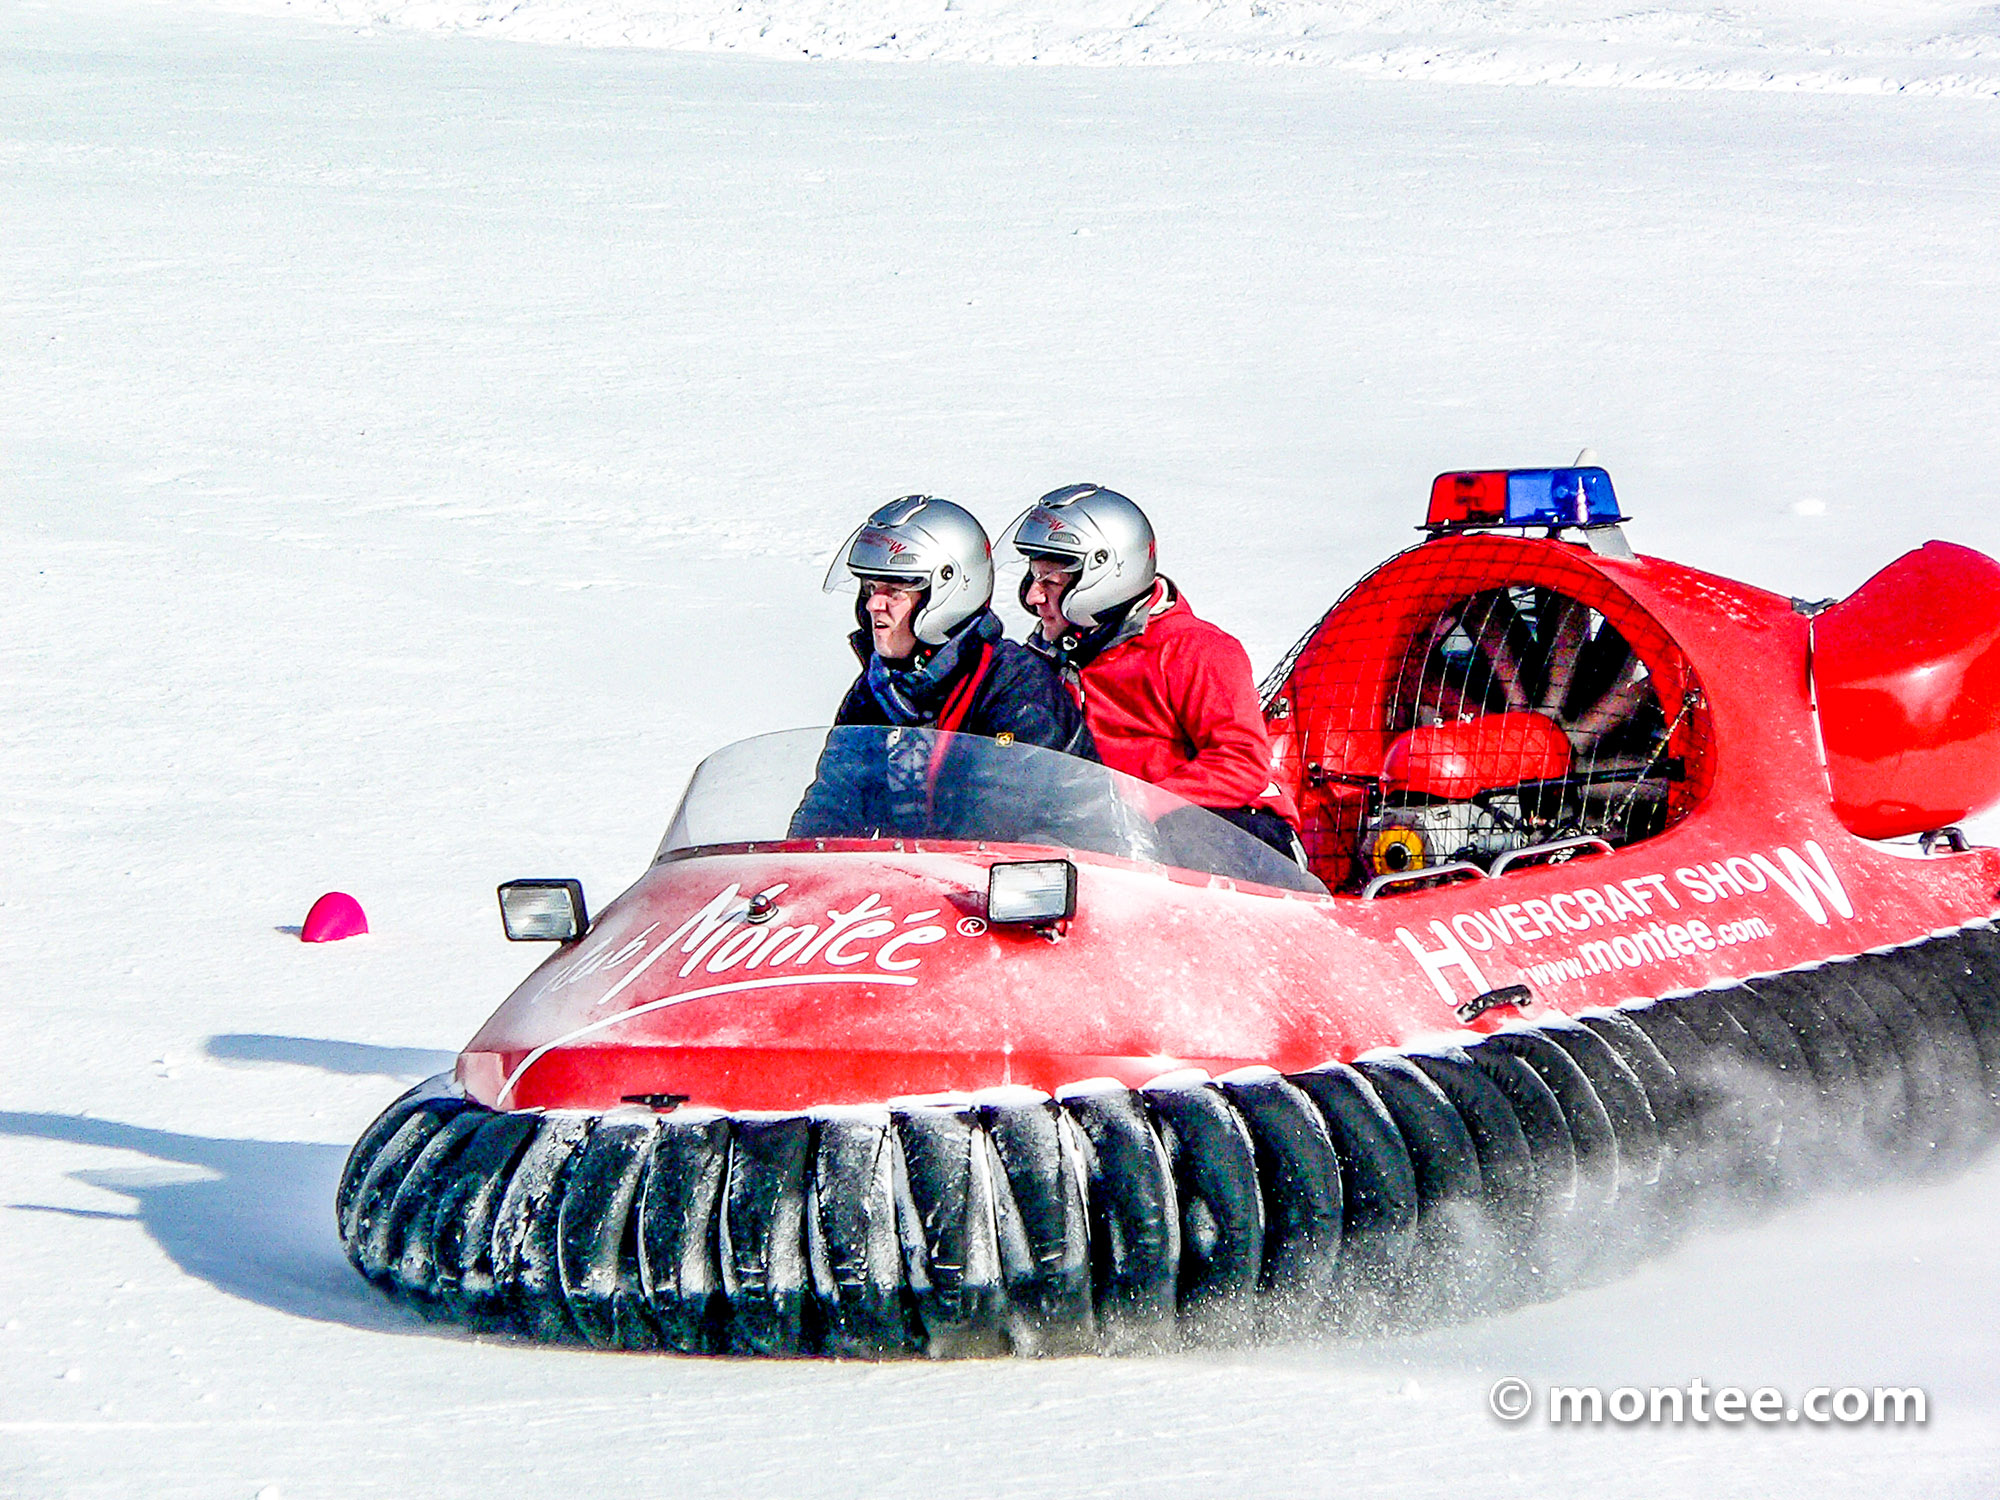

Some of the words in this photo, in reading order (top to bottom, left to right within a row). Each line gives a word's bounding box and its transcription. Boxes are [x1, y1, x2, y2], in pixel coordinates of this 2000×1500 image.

[597, 883, 946, 1005] Montée
[1395, 874, 1681, 1006] HOVERCRAFT
[1679, 840, 1855, 926] SHOW
[1525, 916, 1771, 988] www.montee.com
